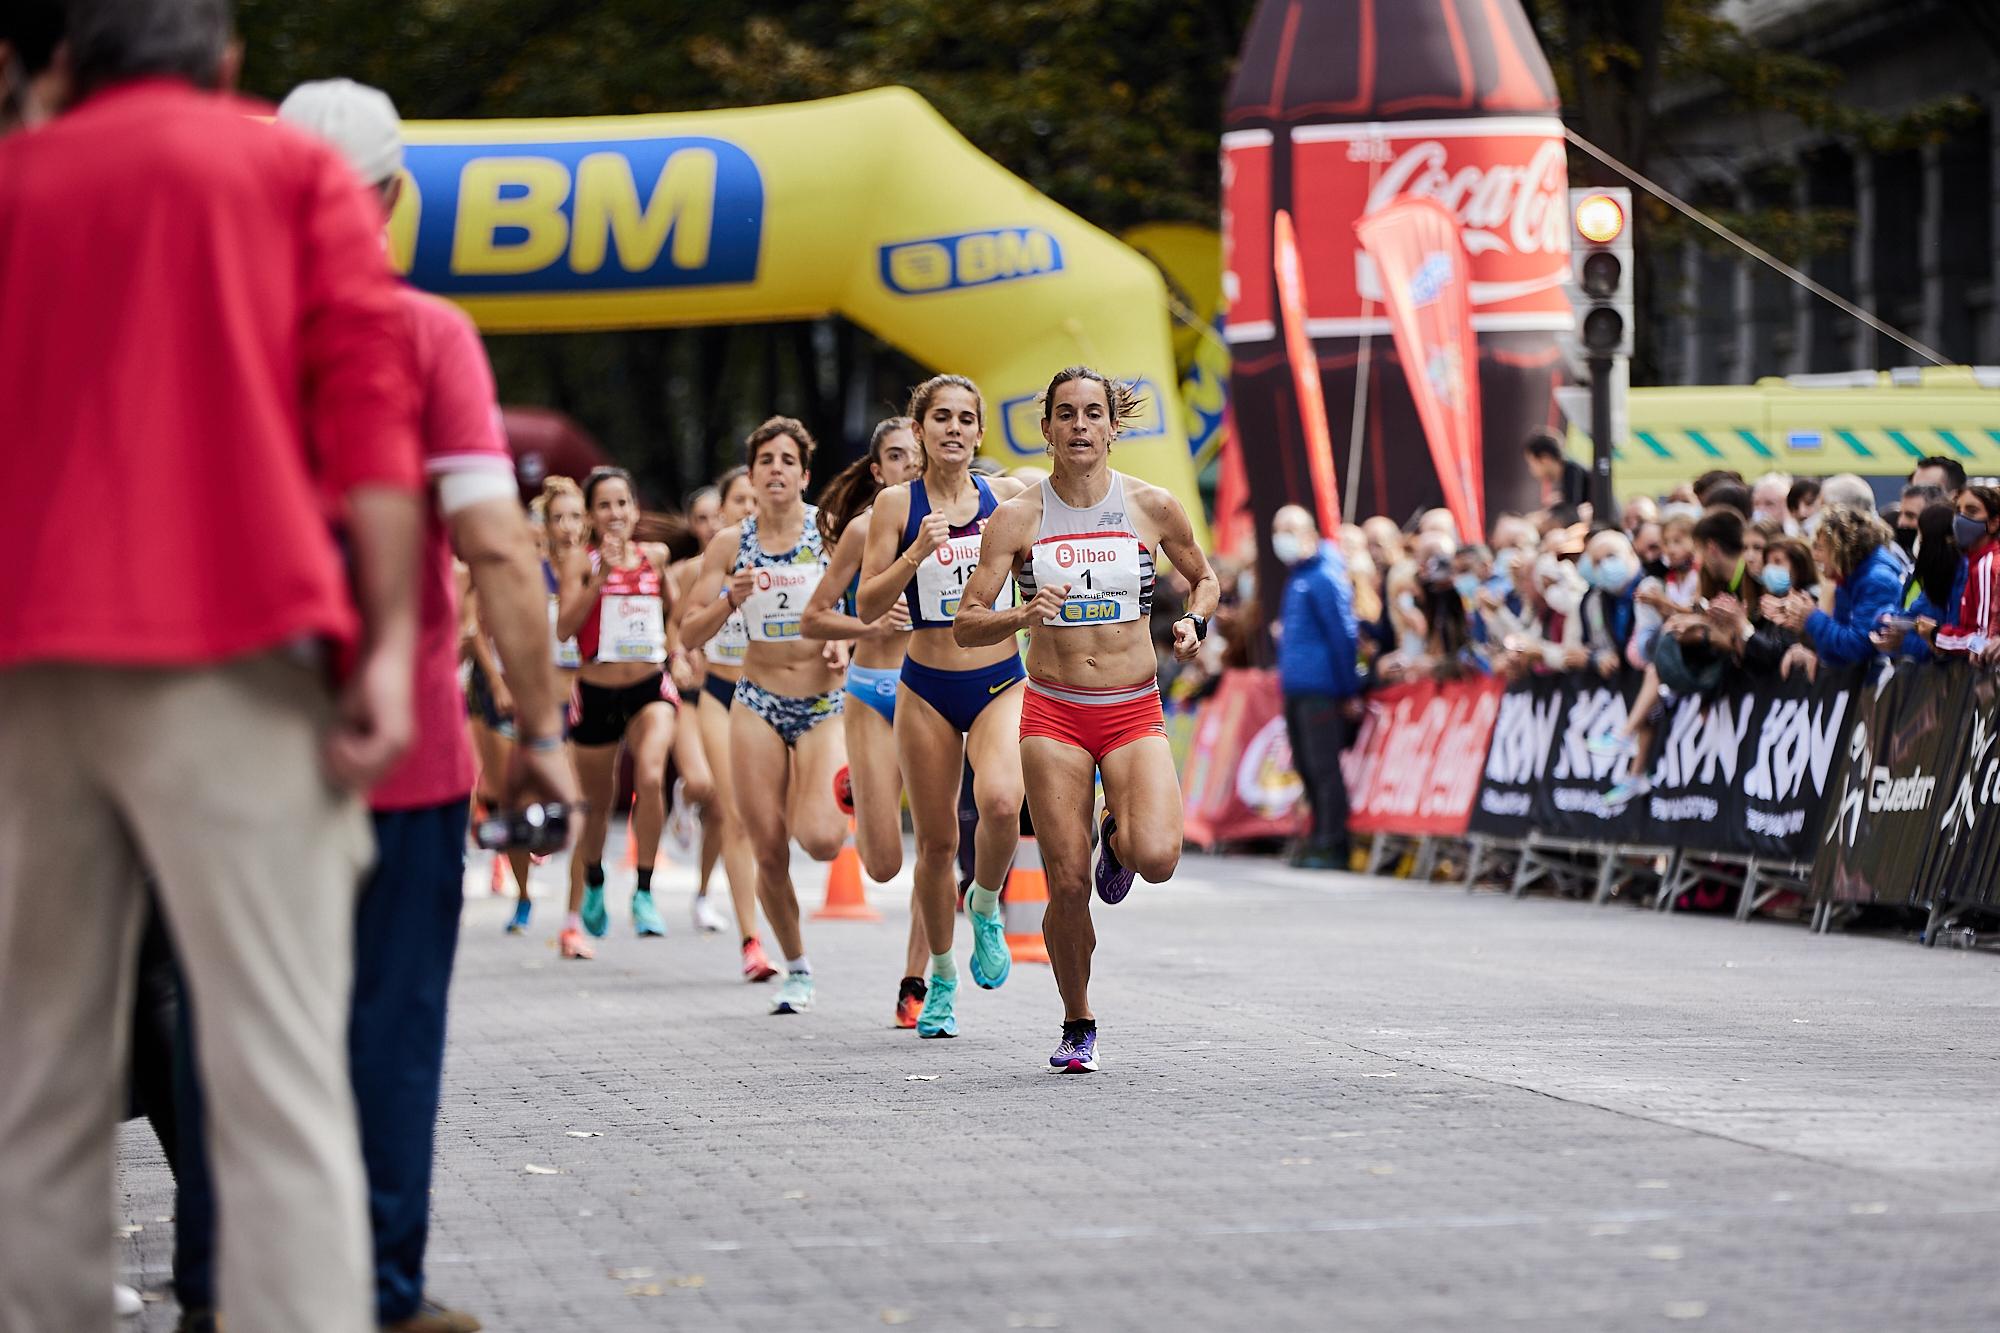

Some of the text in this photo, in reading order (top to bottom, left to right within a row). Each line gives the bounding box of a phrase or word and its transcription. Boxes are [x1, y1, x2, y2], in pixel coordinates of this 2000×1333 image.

[450, 147, 718, 275] BM
[957, 231, 1053, 283] BM
[938, 545, 980, 563] Bilba
[1056, 545, 1116, 566] Bilbao
[1080, 569, 1092, 590] 1
[777, 592, 789, 609] 2
[1086, 602, 1115, 618] BM
